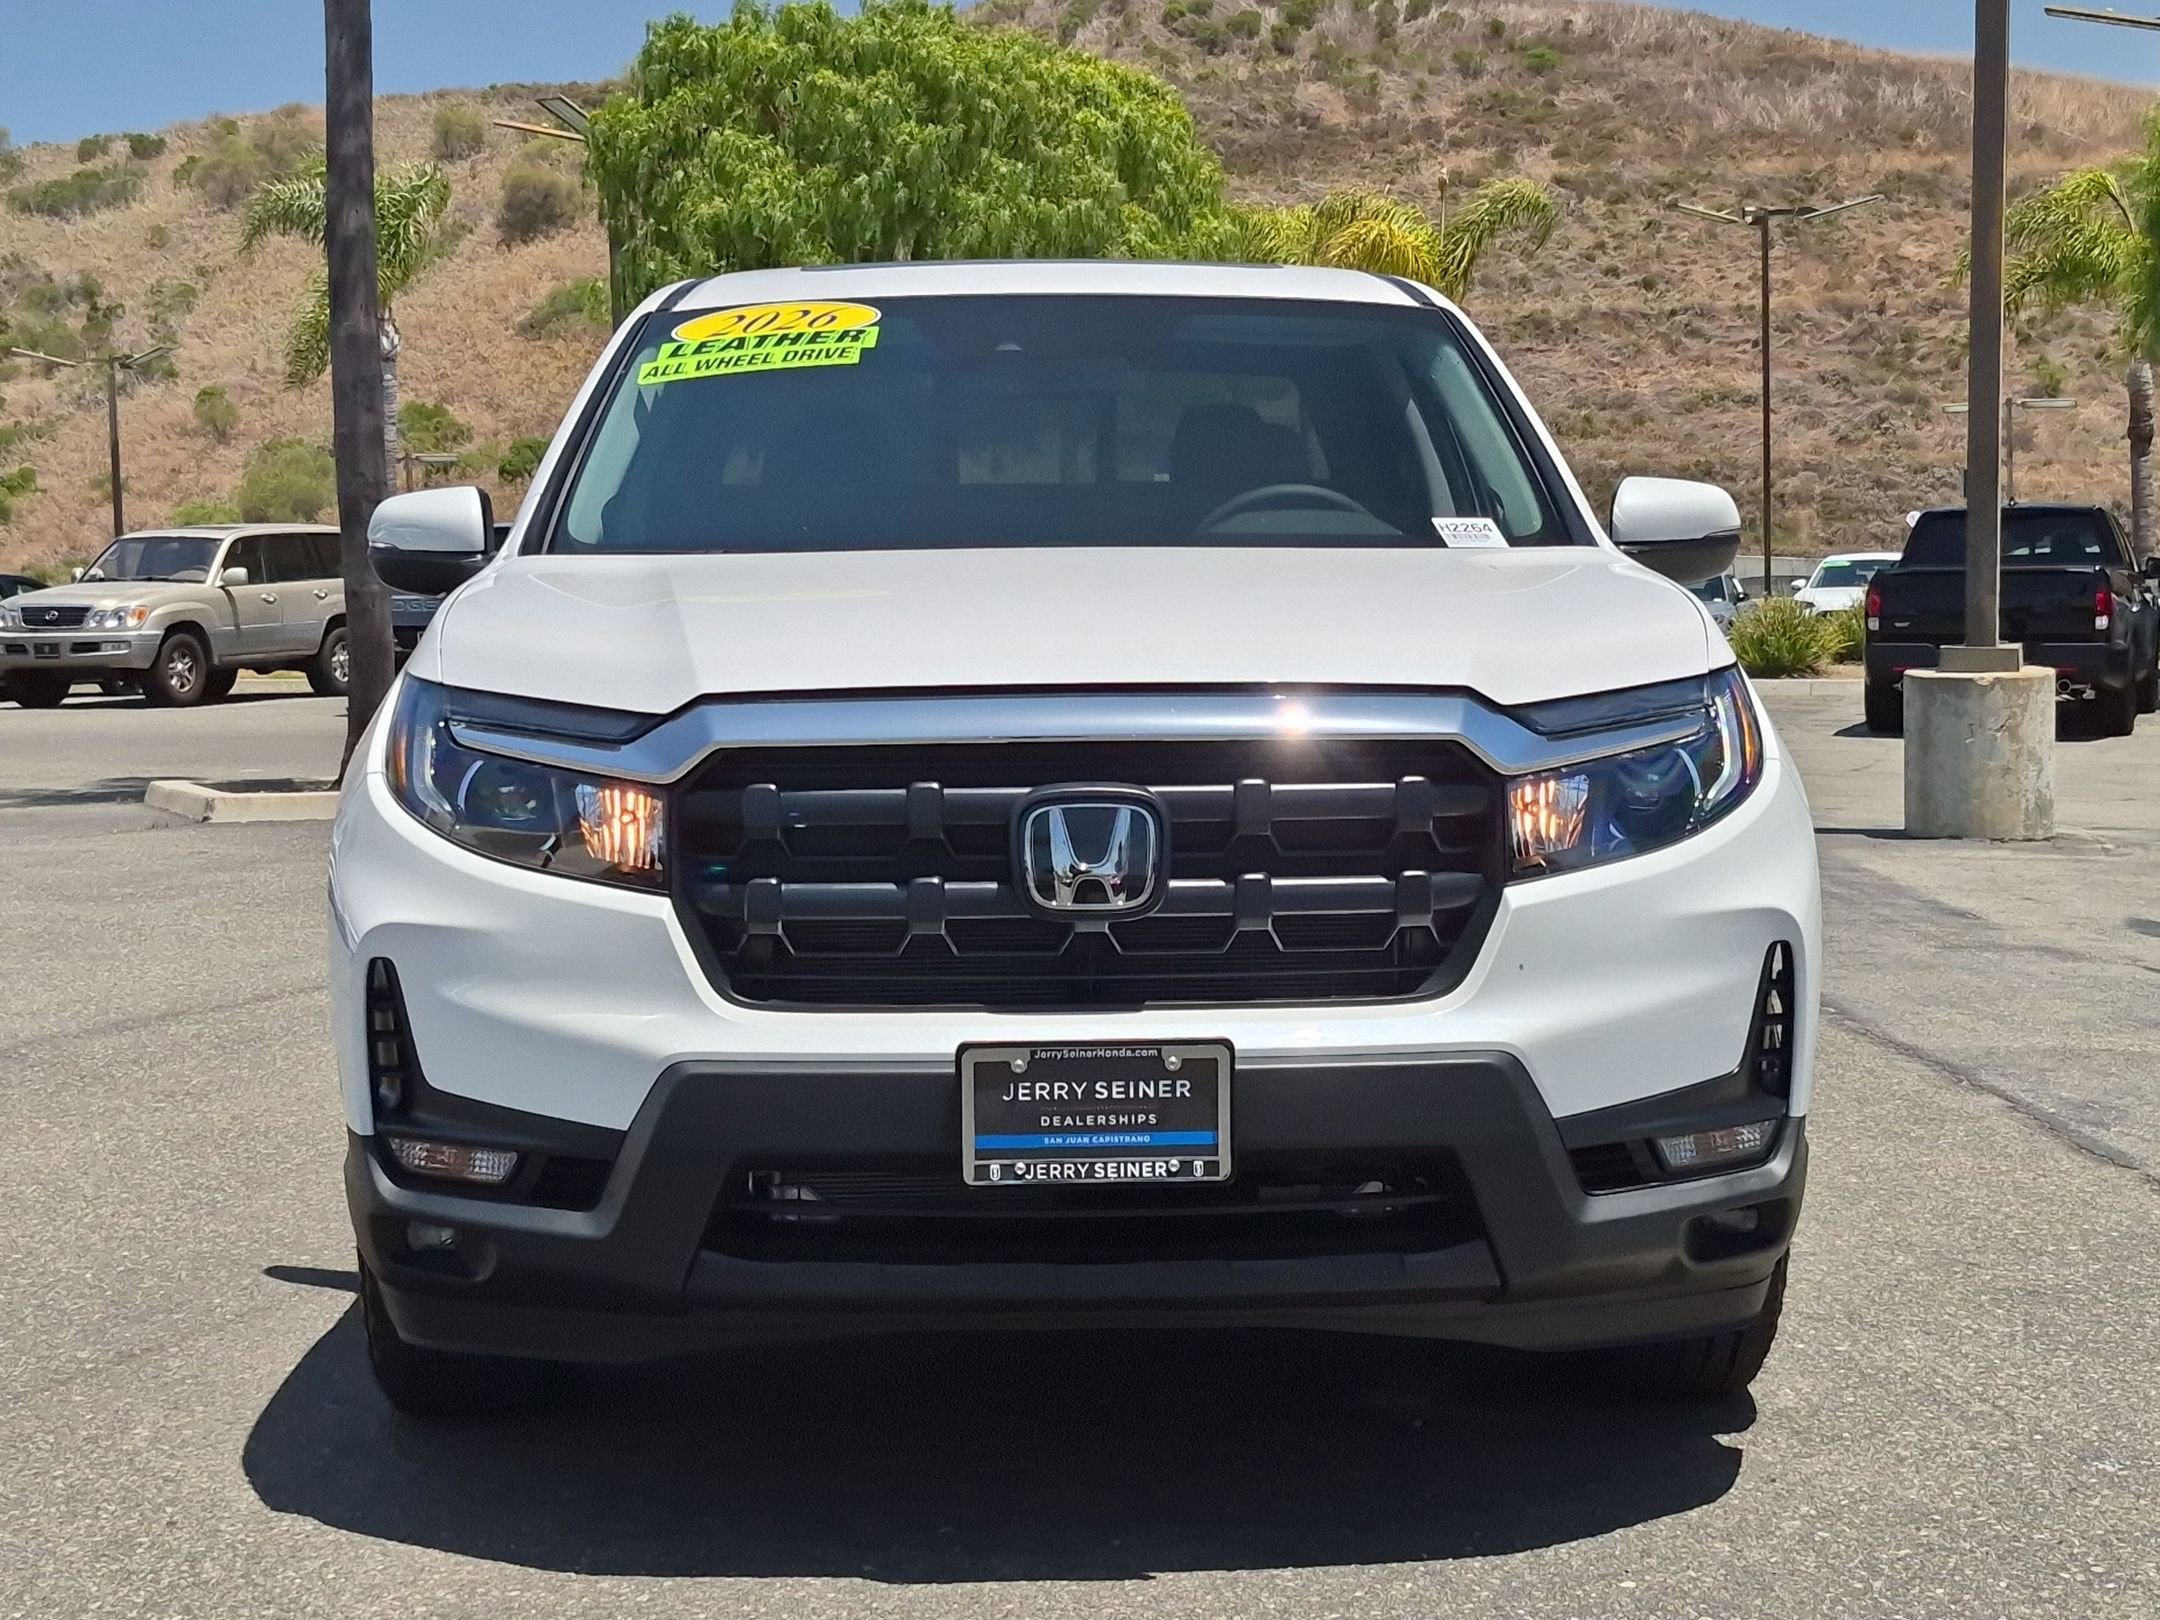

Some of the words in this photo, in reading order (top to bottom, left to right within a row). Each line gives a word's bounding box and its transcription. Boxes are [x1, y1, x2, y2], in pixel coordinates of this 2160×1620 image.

[709, 305, 848, 337] 2026
[667, 329, 868, 358] LEATHER
[643, 364, 685, 379] ALL
[694, 352, 773, 371] WHEEL
[781, 347, 852, 362] DRIVE
[1034, 1048, 1158, 1059] JerrySeinerHonda.com
[1002, 1081, 1088, 1101] JERRY
[1094, 1080, 1192, 1099] SEINER
[1040, 1114, 1157, 1127] DEALERSHIPS
[1044, 1136, 1063, 1145] SAN
[1065, 1136, 1090, 1144] JUAN
[1025, 1162, 1089, 1179] JERRY
[1094, 1161, 1168, 1178] SEINER
